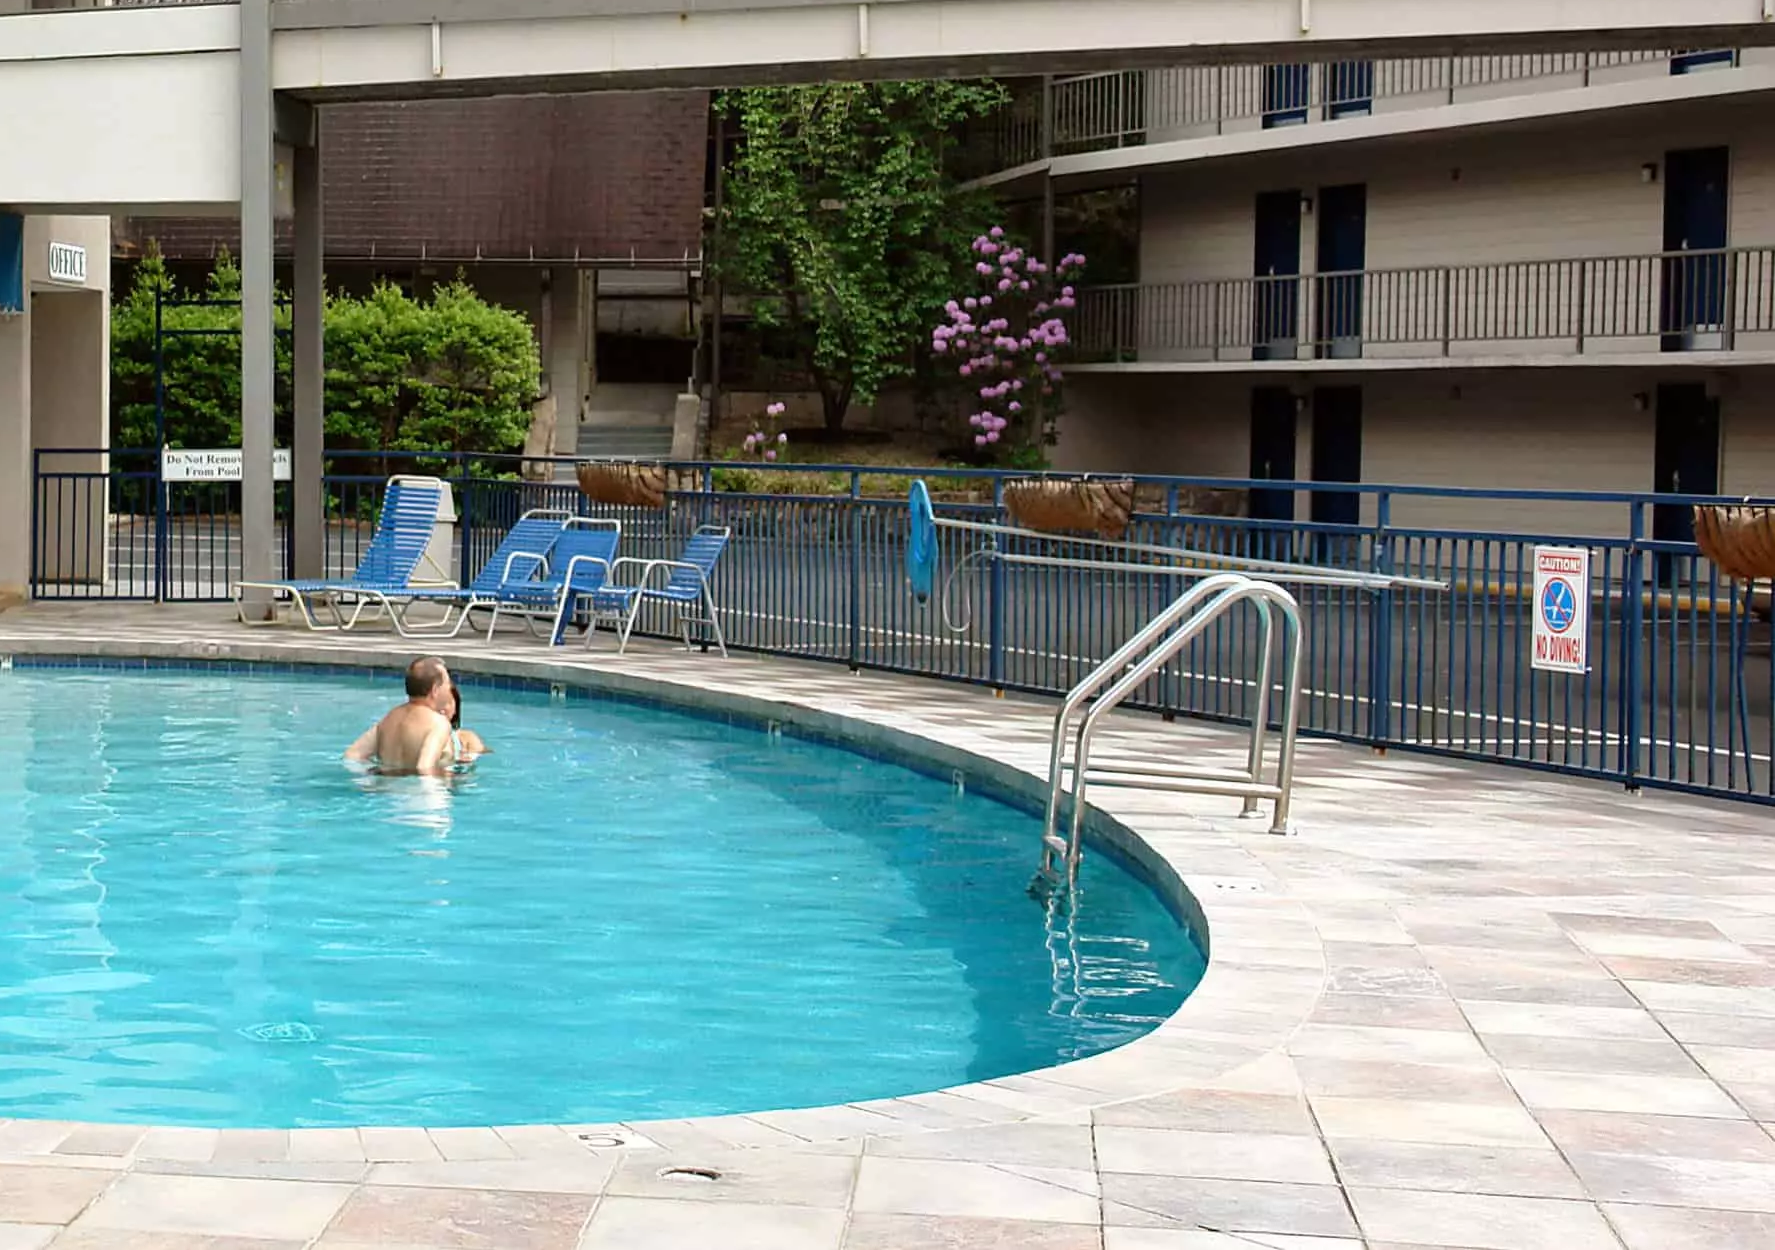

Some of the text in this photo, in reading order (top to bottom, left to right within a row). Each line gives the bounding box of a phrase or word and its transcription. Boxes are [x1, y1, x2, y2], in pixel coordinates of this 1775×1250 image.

[51, 245, 84, 277] OFFICE
[167, 454, 241, 464] Do Not Remov
[186, 466, 240, 477] From Pool
[1539, 556, 1581, 571] CAUTION!
[1536, 634, 1580, 663] NO DIVING!
